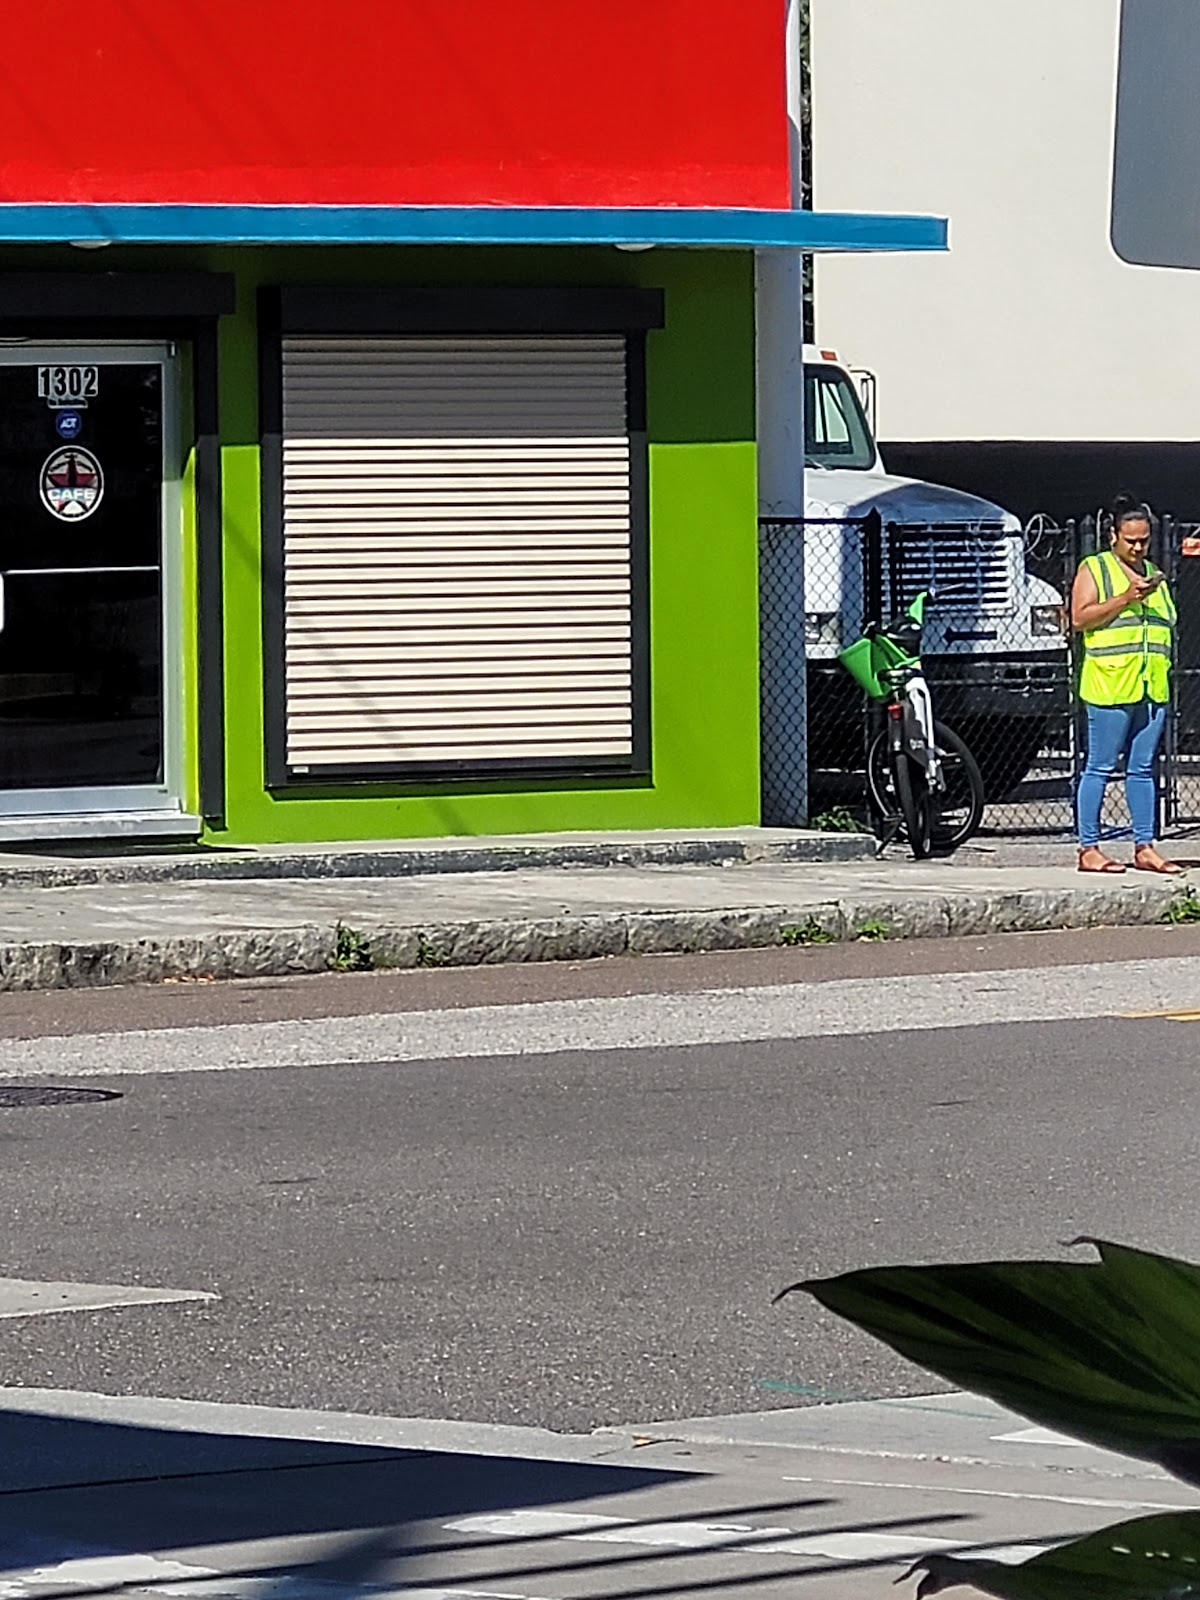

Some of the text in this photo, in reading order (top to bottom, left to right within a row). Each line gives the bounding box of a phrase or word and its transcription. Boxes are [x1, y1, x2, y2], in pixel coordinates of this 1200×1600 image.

[39, 367, 98, 396] 1302
[60, 417, 78, 429] ADT
[48, 487, 95, 500] CAFE
